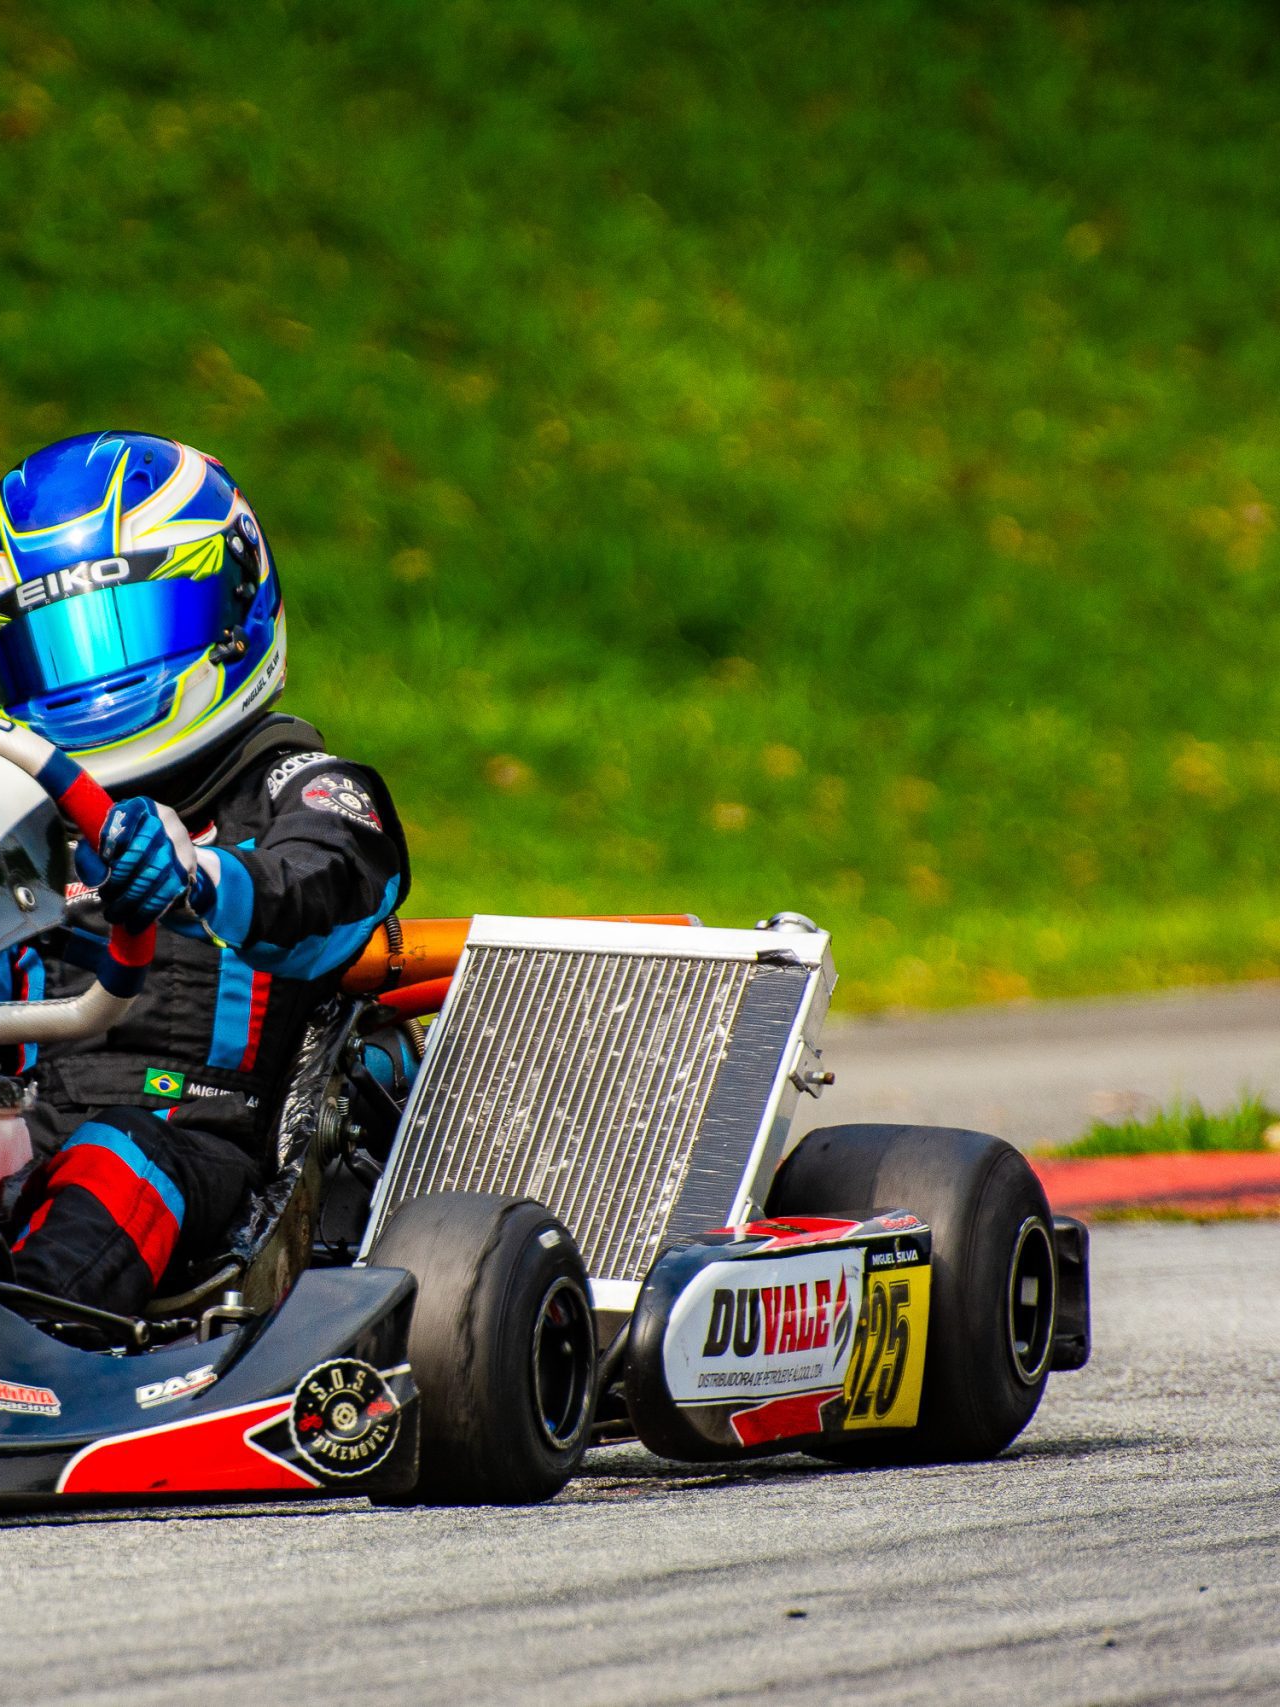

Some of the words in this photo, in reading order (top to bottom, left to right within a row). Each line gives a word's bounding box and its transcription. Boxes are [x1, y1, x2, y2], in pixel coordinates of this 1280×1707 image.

[16, 557, 129, 607] EIKO
[242, 677, 266, 712] MIGUEL
[872, 1252, 895, 1265] MIGUEL
[896, 1249, 919, 1262] SILVA
[702, 1279, 831, 1358] DUVALE
[136, 1364, 216, 1404] DAI
[697, 1370, 753, 1388] DISTRIBUIDORA
